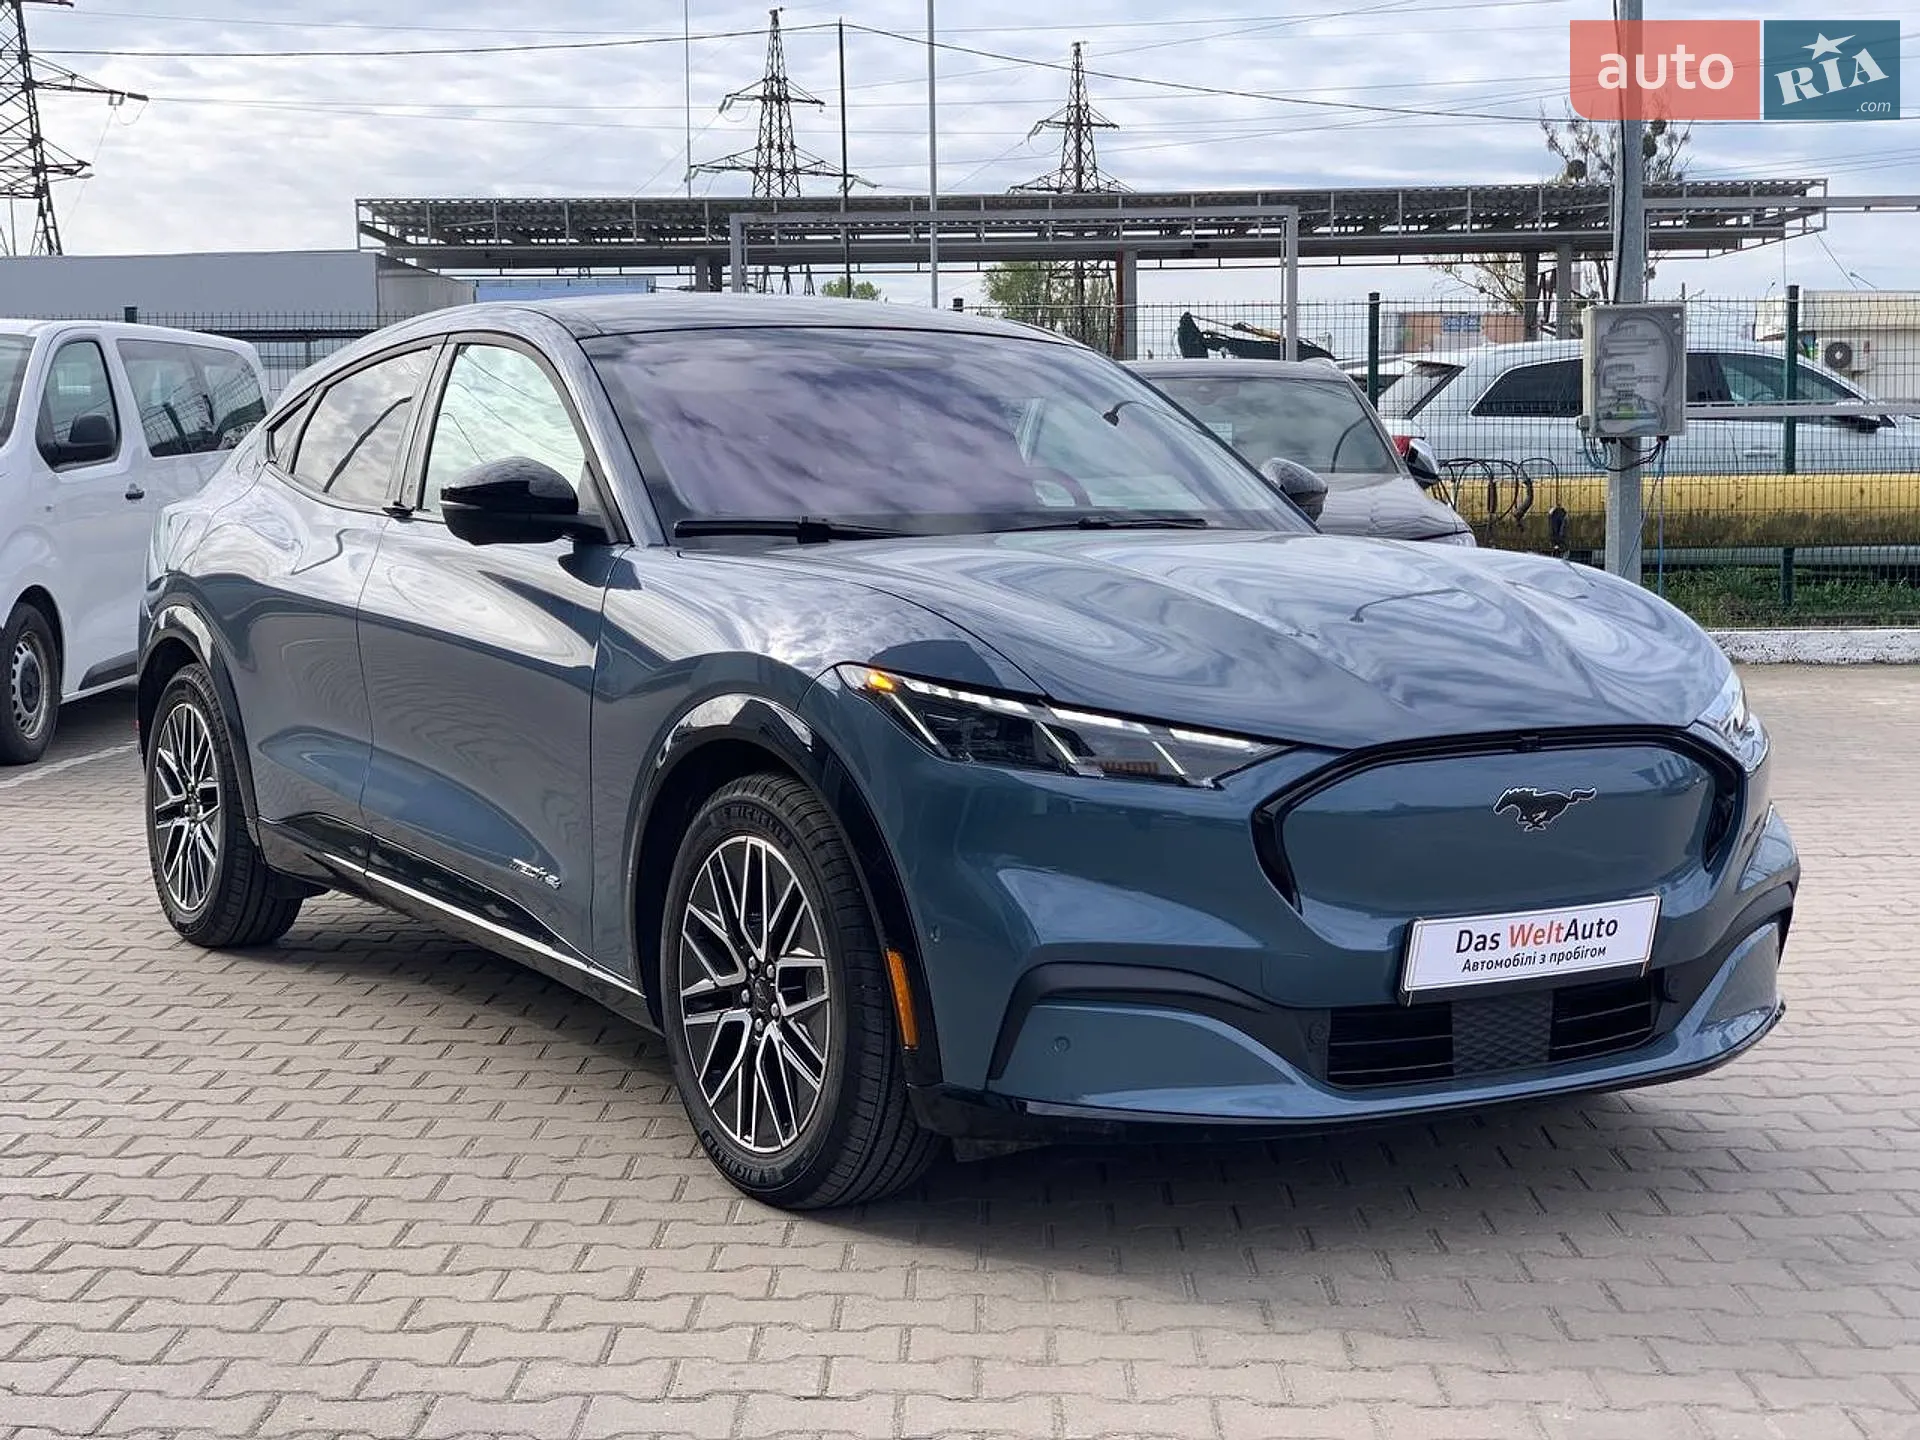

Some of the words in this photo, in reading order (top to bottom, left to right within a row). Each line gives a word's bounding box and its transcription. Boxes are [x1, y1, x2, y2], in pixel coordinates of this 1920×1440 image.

[1456, 930, 1501, 953] Das
[1509, 918, 1618, 948] WeltAuto
[1462, 951, 1536, 973] Автомобілі
[1539, 955, 1546, 965] з
[1550, 945, 1607, 965] пробігом
